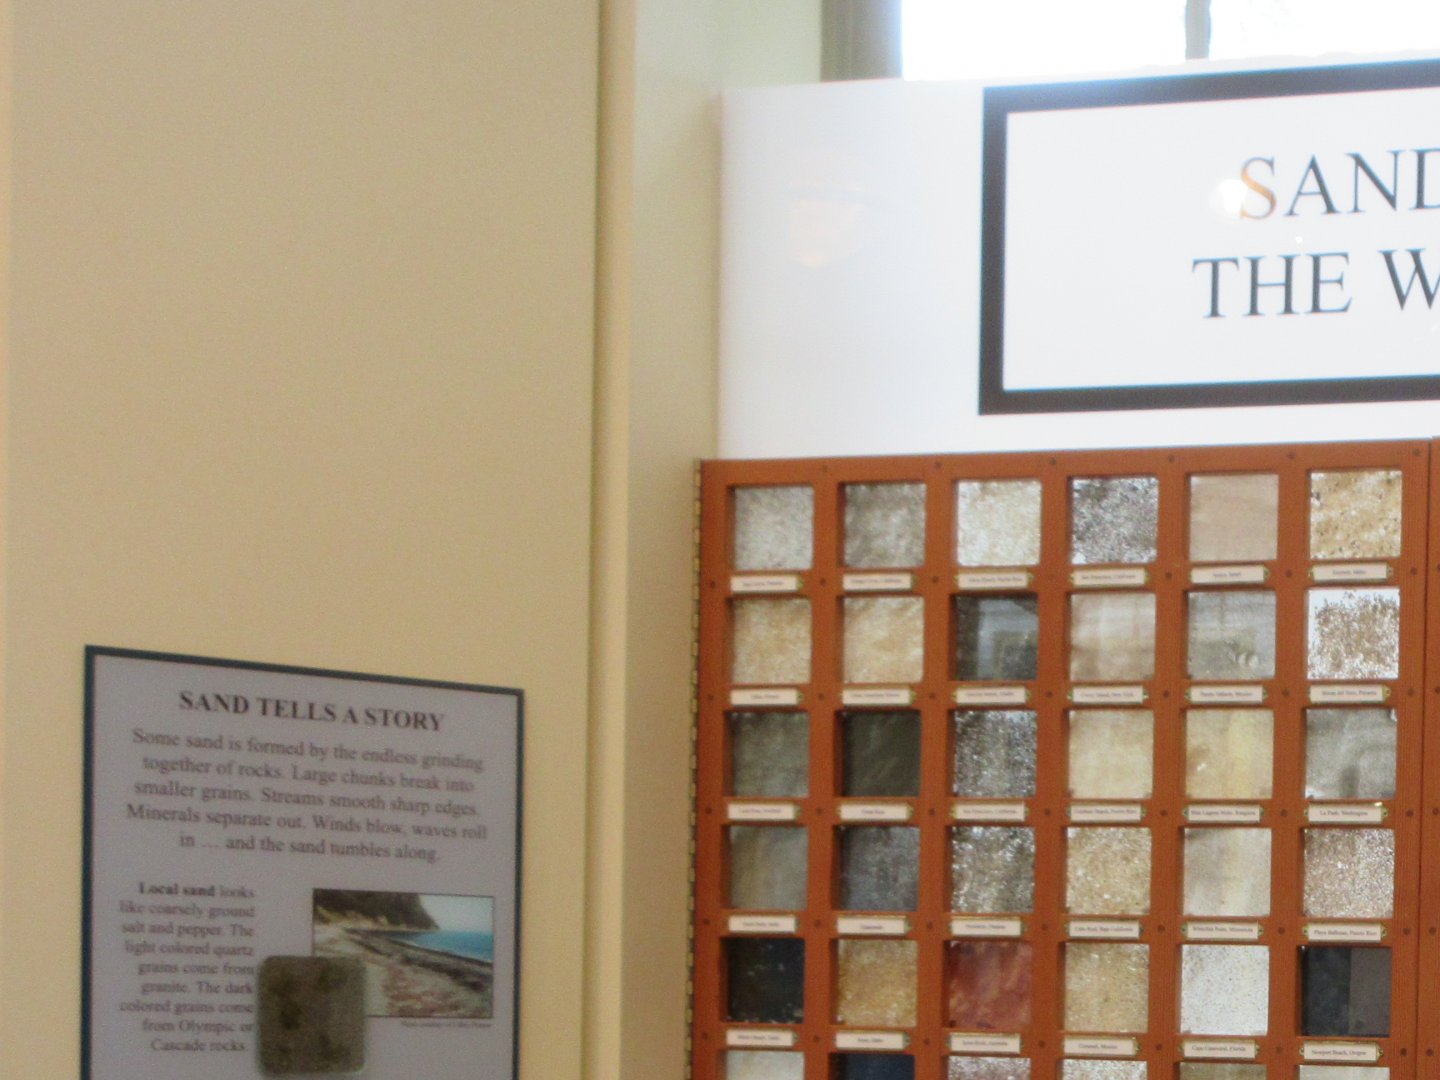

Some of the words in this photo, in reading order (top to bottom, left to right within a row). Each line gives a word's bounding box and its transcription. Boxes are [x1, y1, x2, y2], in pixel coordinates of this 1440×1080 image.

[1192, 252, 1352, 318] THE
[180, 690, 249, 714] SAND
[257, 697, 336, 721] TELLS
[343, 706, 358, 724] A
[364, 709, 444, 731] STORY
[132, 728, 180, 746] Some
[186, 735, 223, 750] sand
[228, 736, 241, 751] is
[248, 736, 304, 756] formed
[309, 742, 327, 760] by
[333, 744, 356, 760] the
[362, 748, 417, 764] endless
[422, 753, 483, 773] grinding
[143, 757, 212, 774] together
[216, 760, 235, 775] of
[291, 764, 337, 786] Large
[341, 770, 395, 787] chunks
[400, 774, 440, 790] break
[445, 778, 474, 792] into
[134, 780, 196, 797] smaller
[260, 788, 324, 806] Streams
[329, 796, 385, 810] smooth
[390, 797, 430, 816] sharp
[127, 804, 200, 822] Minerals
[205, 812, 272, 828] separate
[312, 815, 361, 832] Winds
[412, 824, 457, 838] waves
[462, 825, 487, 839] roll
[179, 831, 195, 847] in
[226, 835, 255, 850] and
[260, 836, 284, 851] the
[289, 840, 325, 854] sand
[329, 842, 391, 858] tumbles
